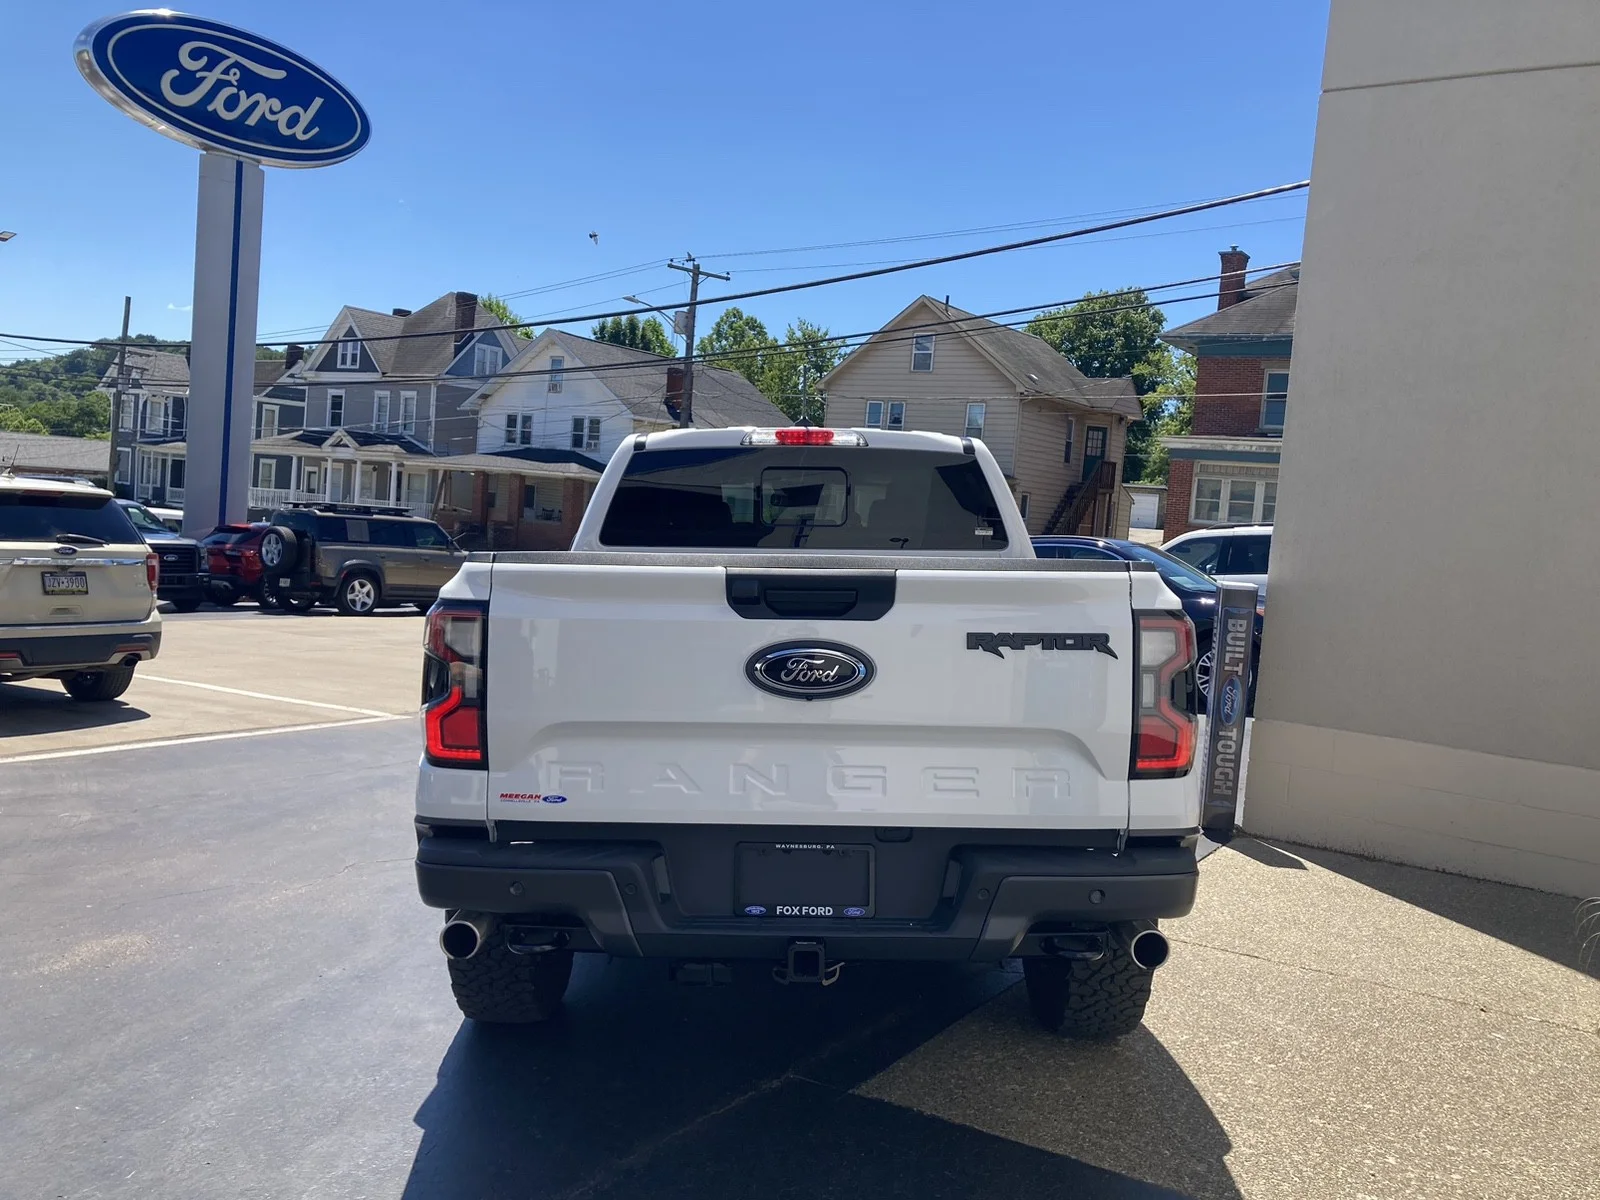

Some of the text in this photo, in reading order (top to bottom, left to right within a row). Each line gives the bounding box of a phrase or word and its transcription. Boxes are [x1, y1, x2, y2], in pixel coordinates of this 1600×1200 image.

[160, 40, 324, 141] Ford
[966, 632, 1119, 660] RAPTOR
[780, 657, 841, 682] Ford
[1213, 618, 1247, 795] BUILT Ford TOUGH
[545, 759, 1073, 800] RANGER
[776, 905, 800, 915] FOX
[802, 906, 834, 916] FORD
